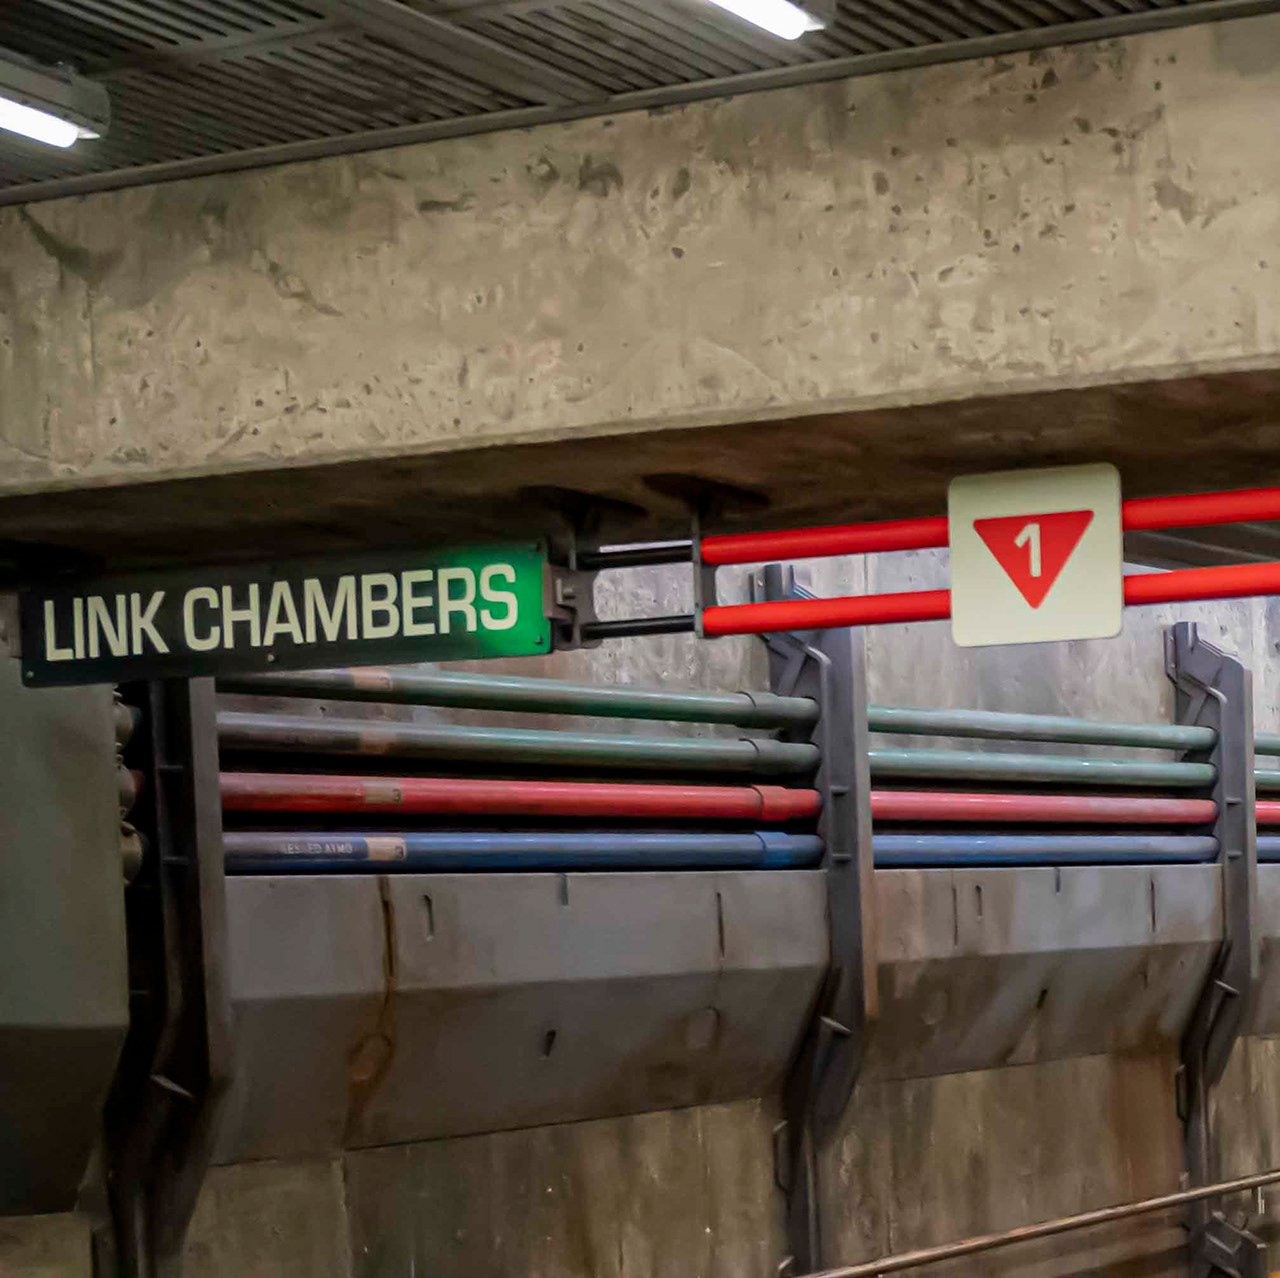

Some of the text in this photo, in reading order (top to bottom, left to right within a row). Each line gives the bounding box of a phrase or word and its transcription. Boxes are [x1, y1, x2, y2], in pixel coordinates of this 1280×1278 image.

[1013, 522, 1042, 578] 1
[43, 562, 519, 662] LINK CHAMBERS
